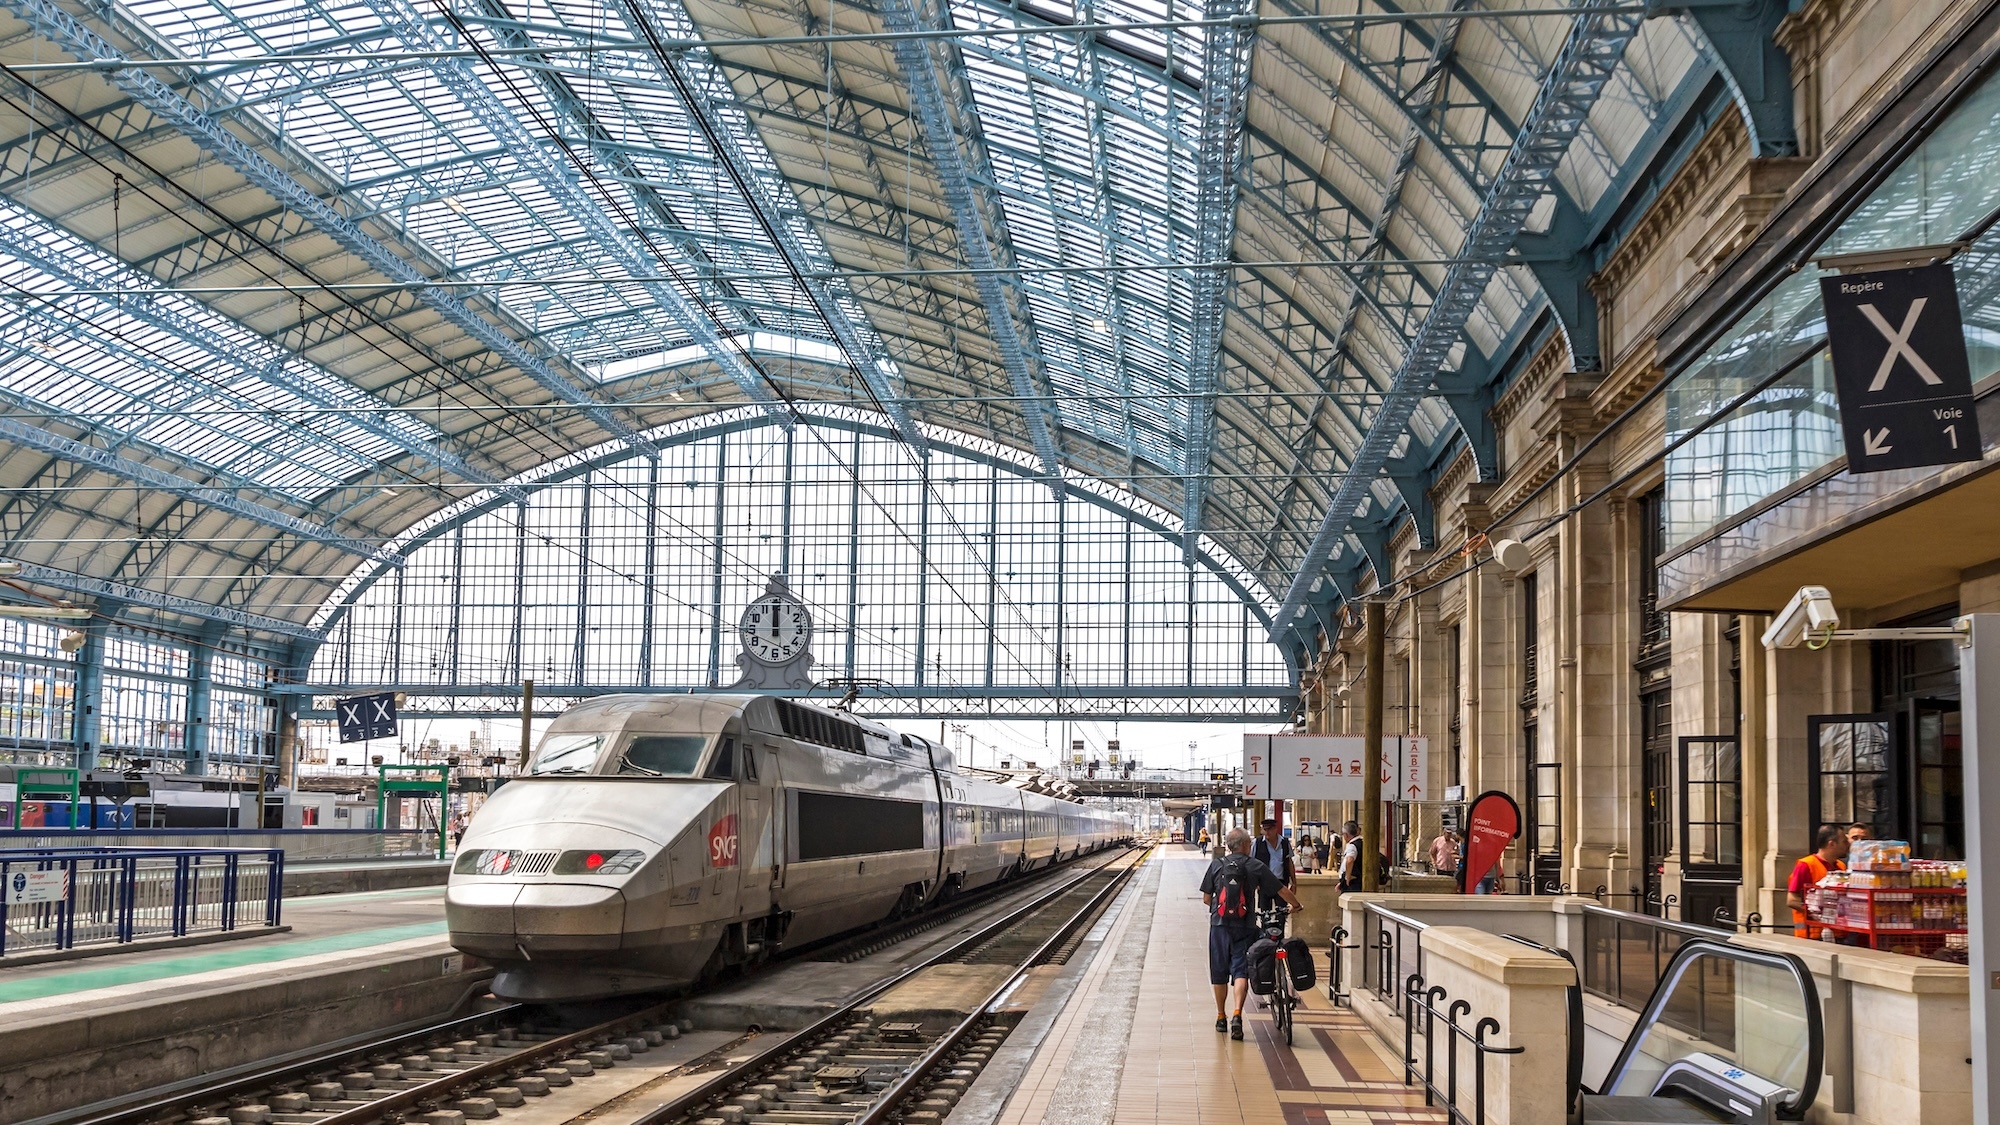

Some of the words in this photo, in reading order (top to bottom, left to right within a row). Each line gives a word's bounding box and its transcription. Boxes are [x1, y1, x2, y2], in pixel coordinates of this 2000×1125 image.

[1841, 280, 1884, 295] Repère
[1857, 297, 1943, 392] X
[1933, 407, 1963, 421] Voie
[1943, 424, 1958, 449] 1
[762, 605, 768, 614] 11
[787, 605, 790, 614] 1
[752, 613, 760, 623] 10
[793, 613, 800, 623] 2
[752, 636, 759, 647] 8
[791, 636, 799, 647] 4
[761, 645, 768, 655] 7
[771, 648, 779, 658] 6
[783, 645, 790, 655] 5
[343, 703, 361, 727] X
[373, 699, 391, 722] X
[1411, 743, 1418, 751] A
[1411, 757, 1418, 766] B
[1251, 762, 1258, 773] 1
[1301, 762, 1309, 774] 2
[1326, 763, 1343, 775] 14
[1410, 772, 1418, 781] C
[1474, 818, 1491, 826] POINT
[713, 836, 737, 860] SNCF
